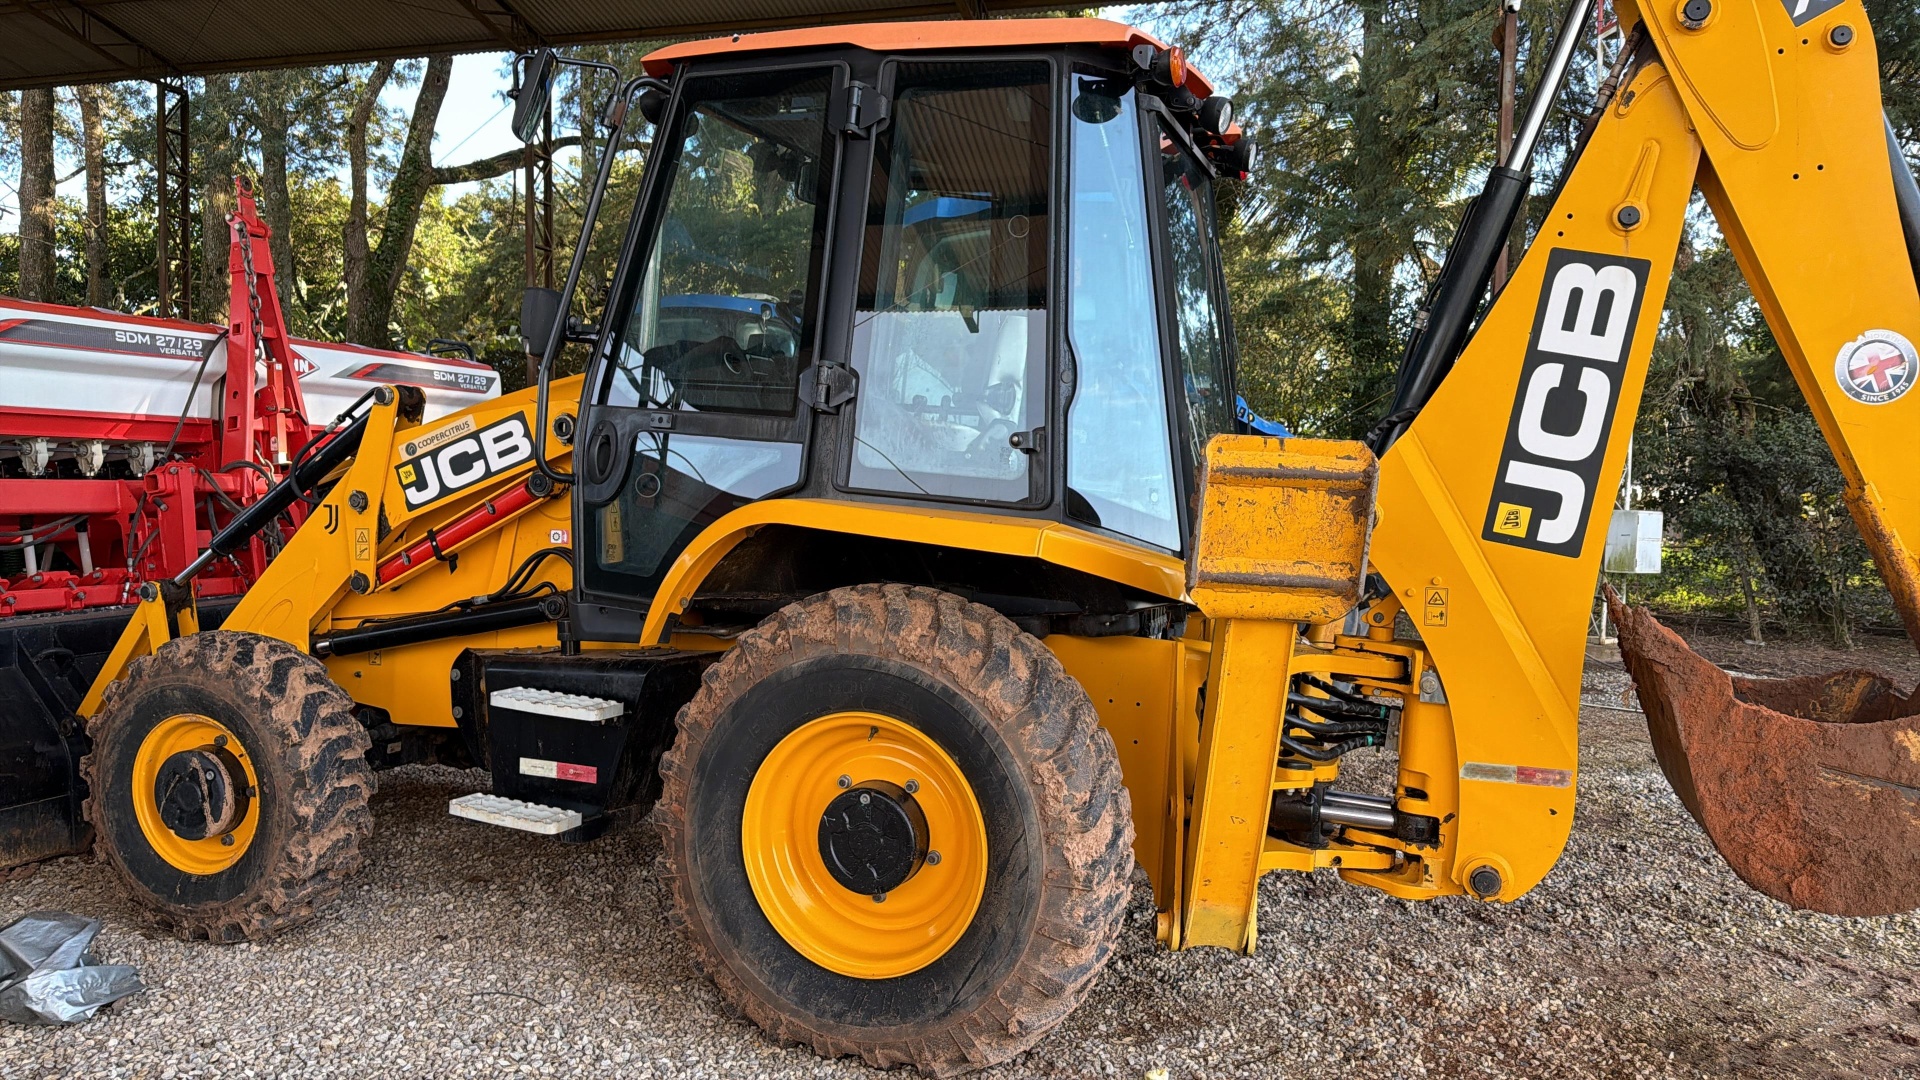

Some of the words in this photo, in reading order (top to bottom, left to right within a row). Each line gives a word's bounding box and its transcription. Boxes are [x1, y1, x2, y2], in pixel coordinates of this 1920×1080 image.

[115, 330, 151, 346] SDM
[160, 347, 204, 358] VERSATILE
[433, 370, 456, 382] SDM
[460, 383, 488, 391] VERSATILE
[1861, 393, 1890, 402] SINCE
[1892, 381, 1909, 397] 1945
[1504, 262, 1637, 545] JCB
[417, 420, 470, 449] COOPERCITRUS
[405, 419, 532, 505] JCB
[1503, 510, 1520, 528] JCB
